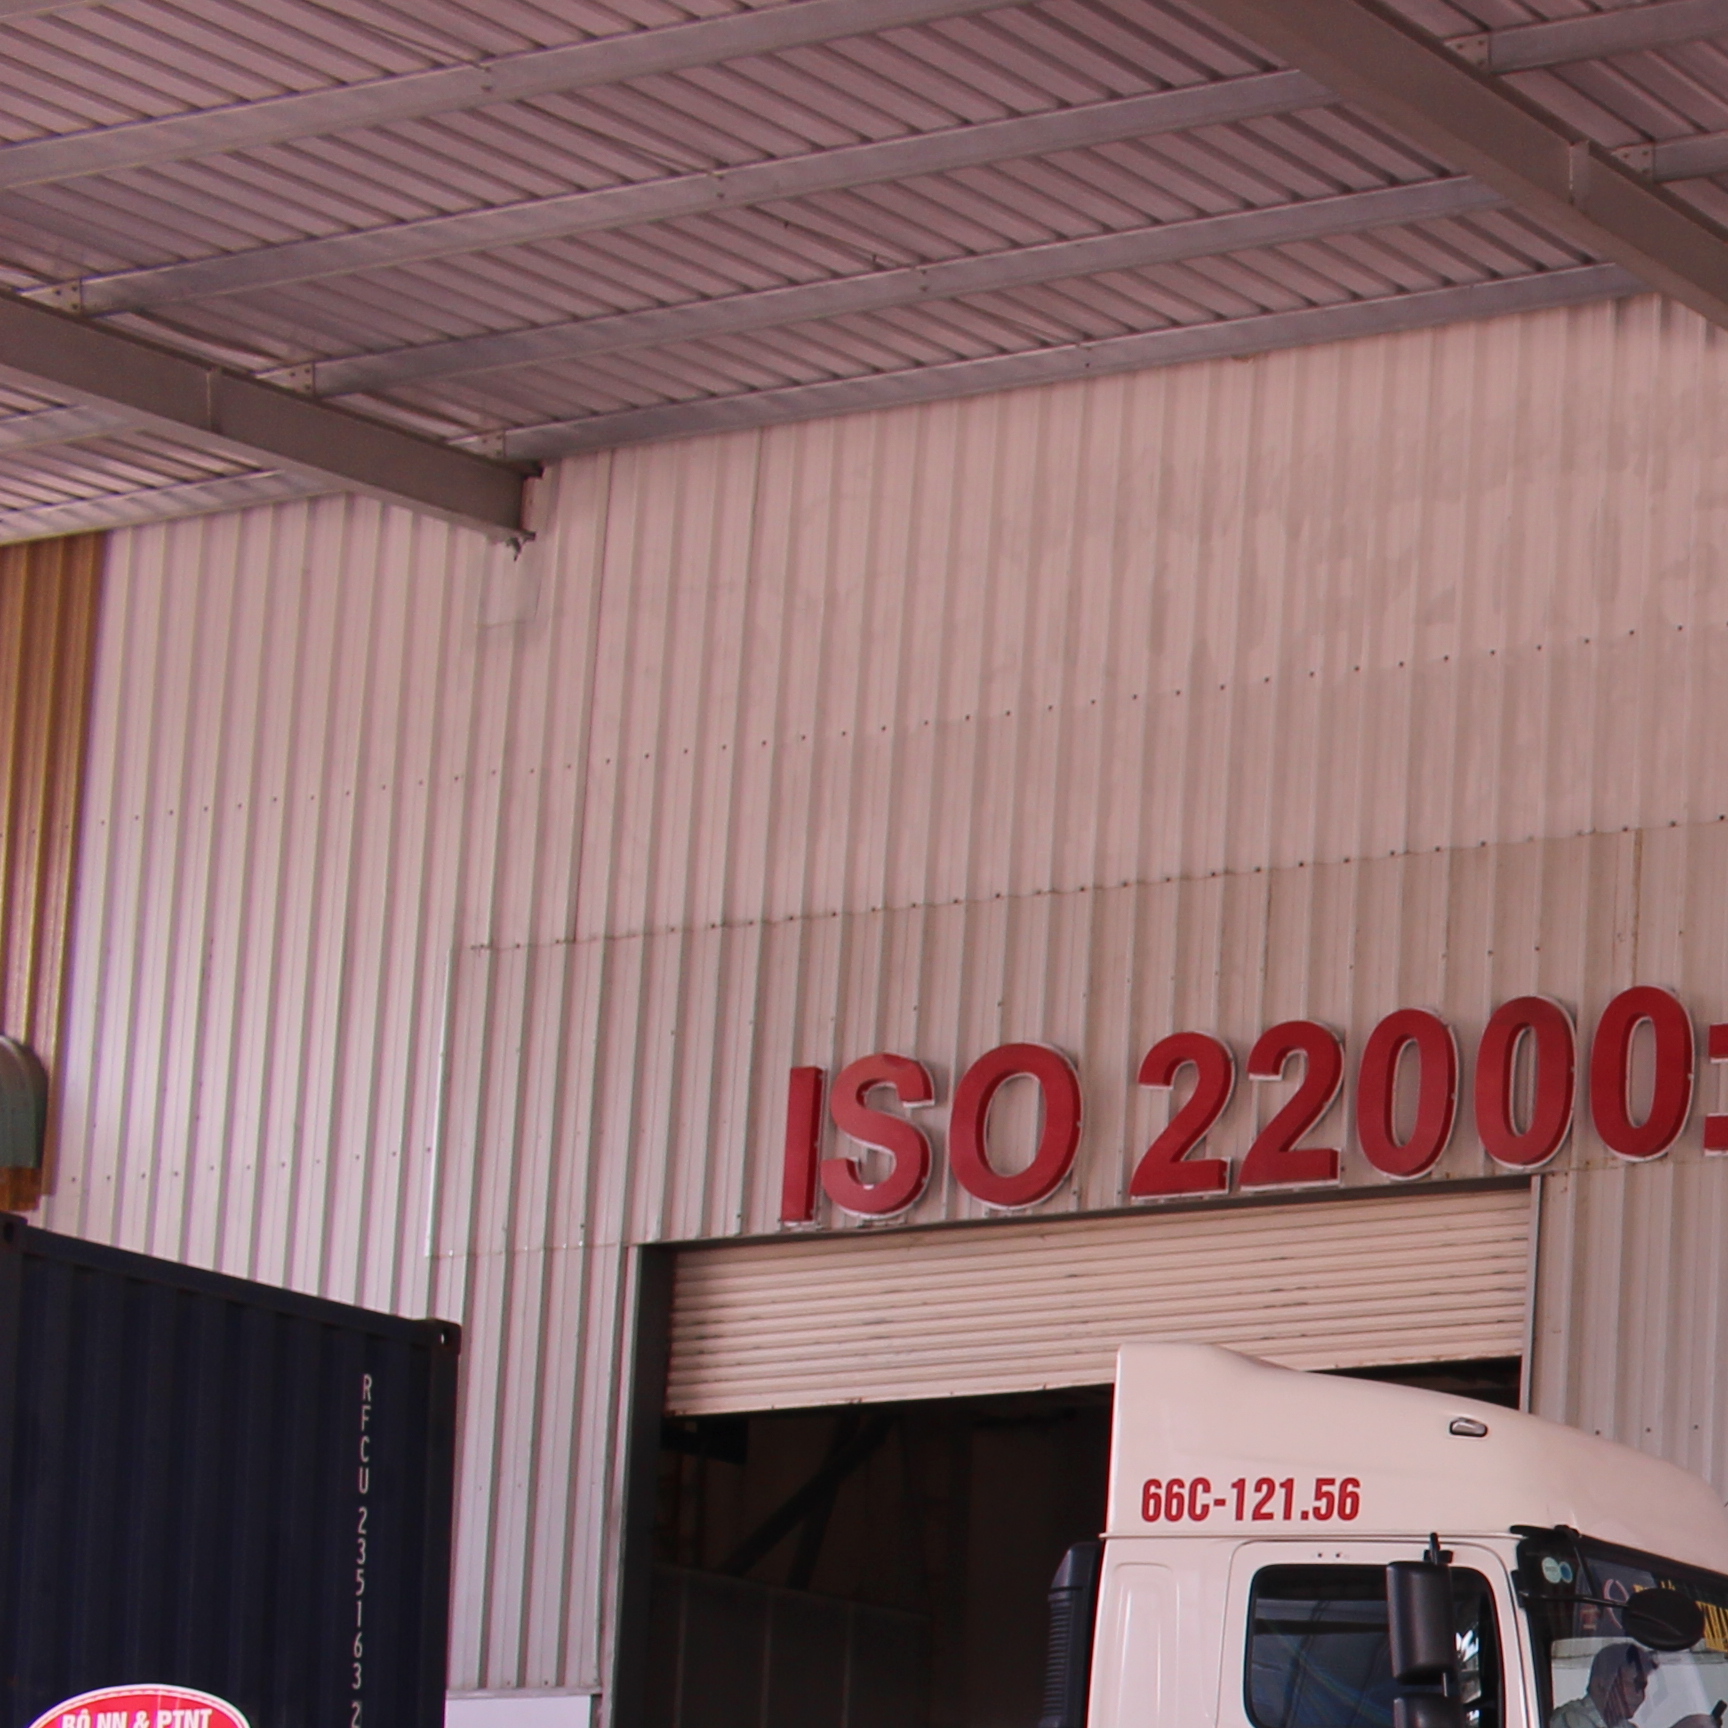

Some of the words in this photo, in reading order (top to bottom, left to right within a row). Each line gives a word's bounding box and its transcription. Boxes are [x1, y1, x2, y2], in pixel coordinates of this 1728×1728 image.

[778, 1043, 1083, 1226] ISO
[357, 1373, 373, 1495] RFCU
[1140, 1476, 1362, 1523] 66C-121.56
[351, 1505, 369, 1690] 235163
